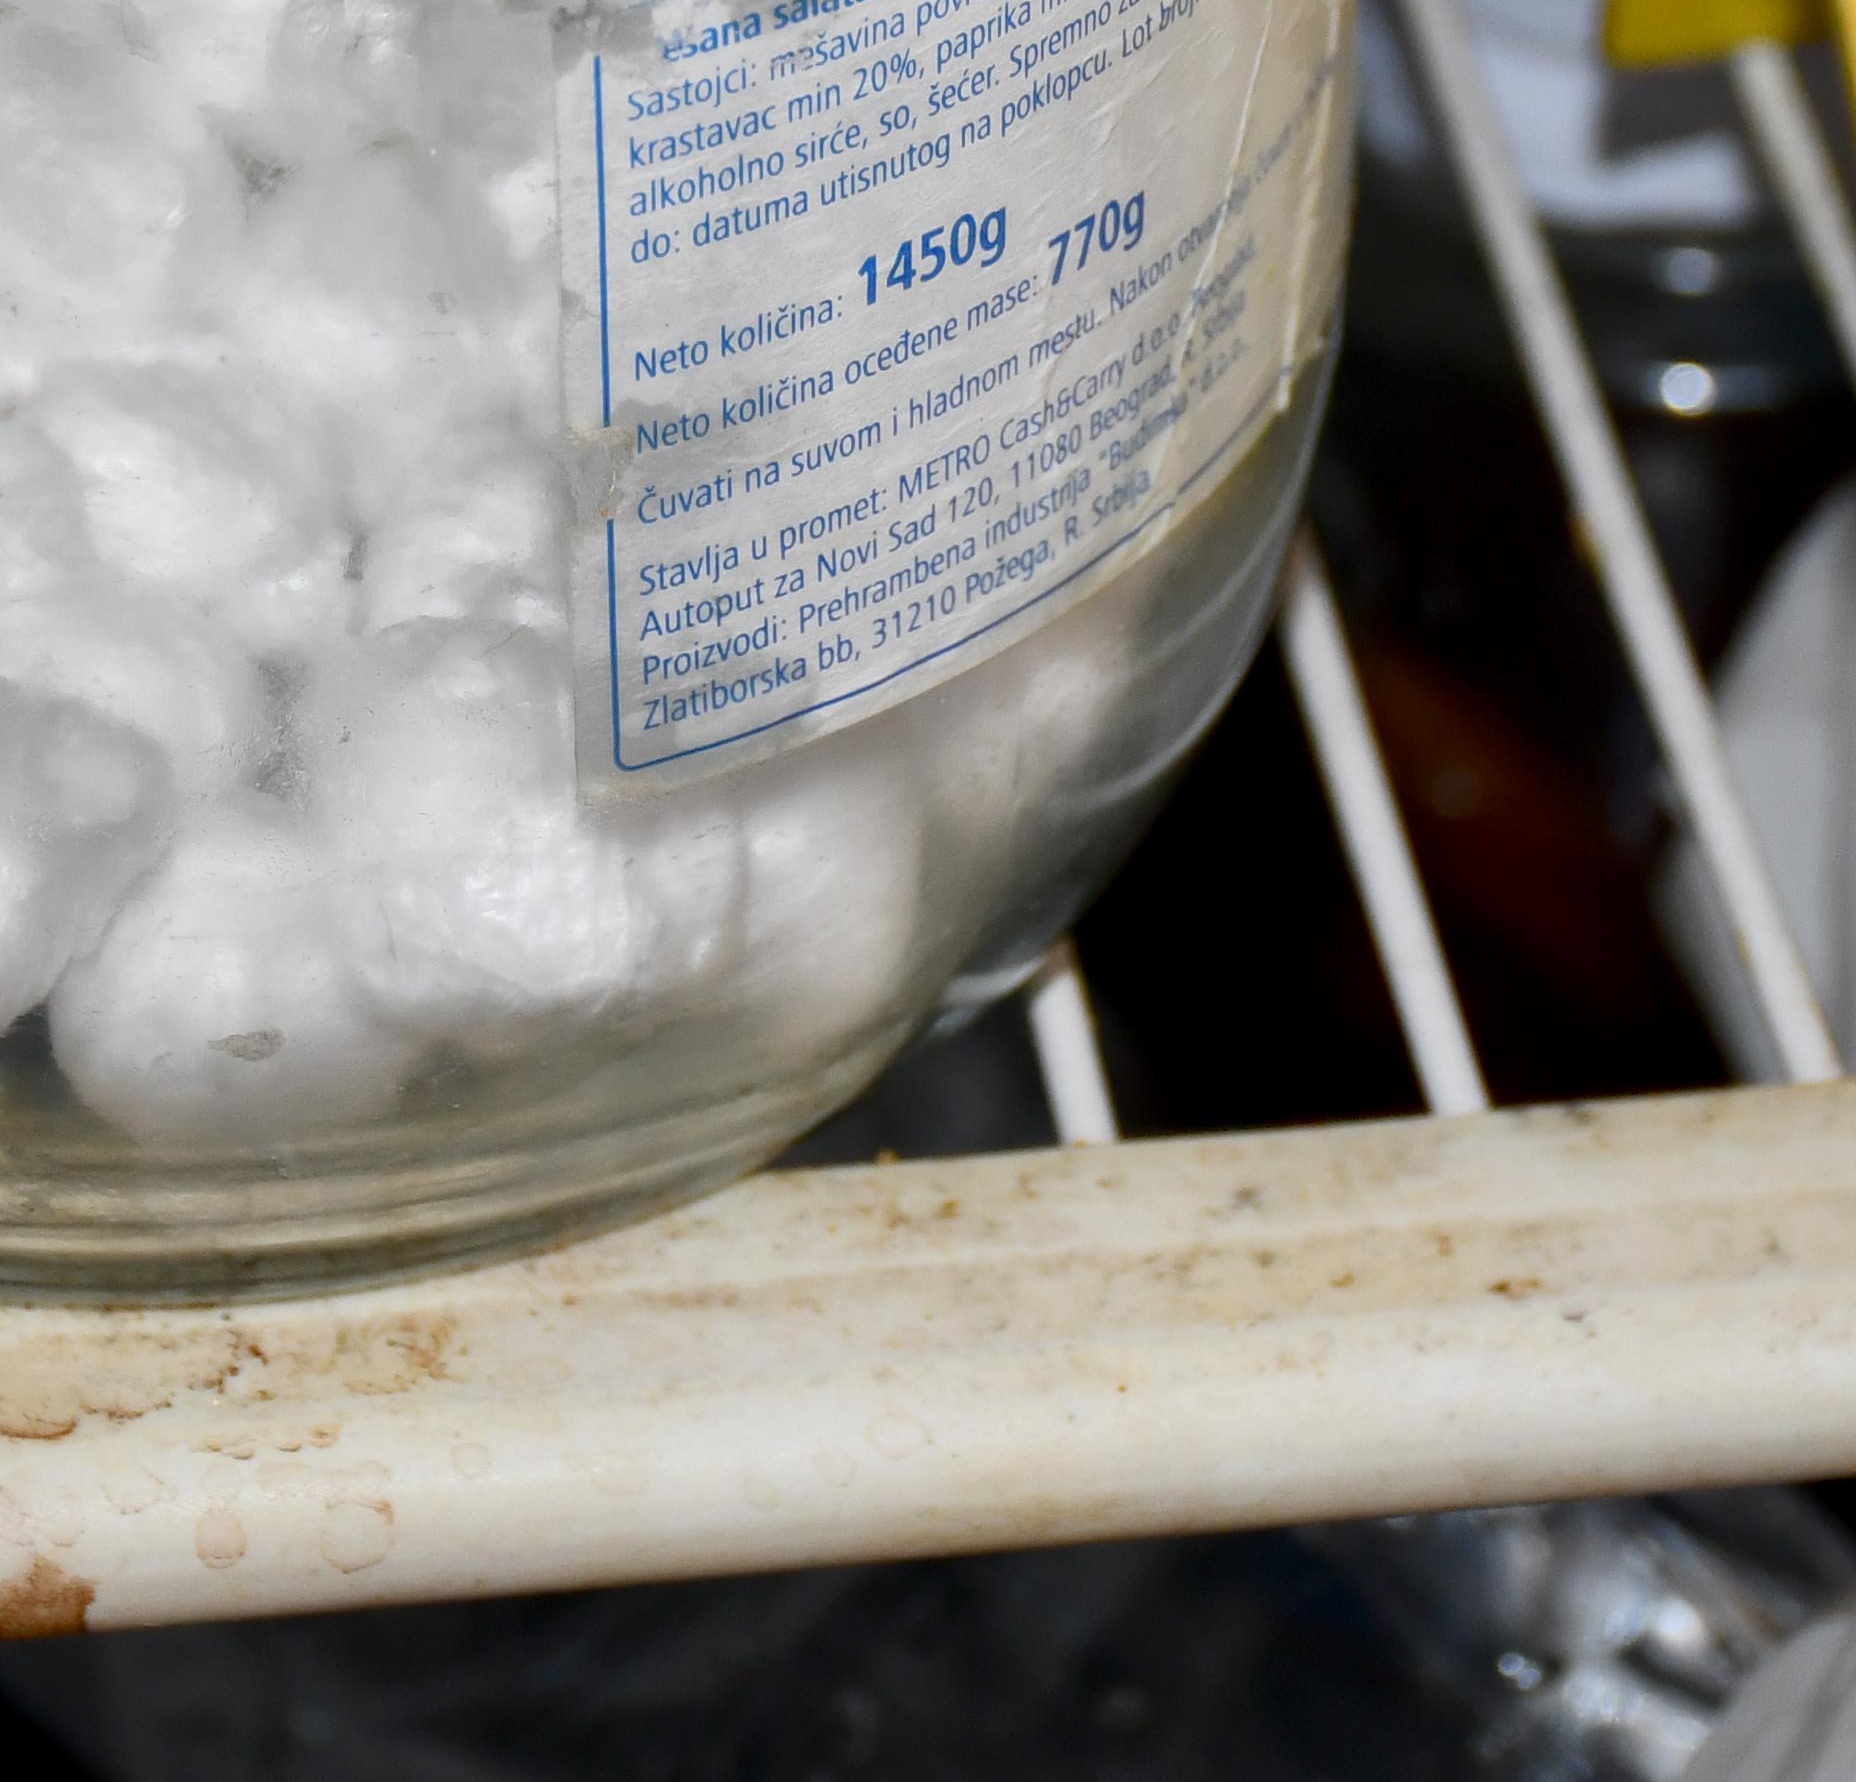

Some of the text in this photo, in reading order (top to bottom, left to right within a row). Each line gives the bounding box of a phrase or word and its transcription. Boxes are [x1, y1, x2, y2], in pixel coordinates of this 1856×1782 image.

[628, 58, 757, 120] Sastojci:
[629, 105, 776, 169] krastavac
[788, 82, 841, 123] min
[852, 49, 925, 100] 20%,
[630, 151, 783, 217] alkoholno
[795, 124, 867, 167] sirće,
[880, 105, 917, 137] so,
[928, 63, 999, 116] šećer.
[1009, 0, 1111, 80] Spremno
[632, 230, 680, 263] do:
[693, 192, 808, 247] datuma
[820, 133, 950, 206] utisnutog
[961, 117, 991, 148] na
[1001, 54, 1112, 137] poklopcu.
[1122, 18, 1152, 58] Lot
[635, 207, 1007, 381] Neto količina: 1450g
[637, 191, 1144, 454] Neto količina oceđene mase: 770g
[637, 251, 1172, 524] Čuvati na suvom i hladnom mestu. Nakon
[639, 546, 738, 596] Stavlja
[751, 537, 766, 559] u
[780, 487, 887, 559] promet:
[898, 434, 989, 503] METRO
[999, 352, 1125, 450] Cash&Carry
[640, 579, 764, 641] Autoput
[775, 568, 804, 599] za
[817, 531, 878, 582] Novi
[888, 504, 936, 552] Sad
[949, 477, 1000, 523] 120,
[1012, 427, 1082, 488] 11080
[643, 615, 787, 684] Proizvodi:
[799, 536, 976, 634] Prehrambena
[985, 466, 1091, 549] industrija
[644, 657, 806, 730] Zlatiborska
[819, 634, 860, 672] bb,
[872, 586, 956, 649] 31210
[965, 538, 1056, 613] Požega,
[1092, 468, 1152, 527] Srbija
